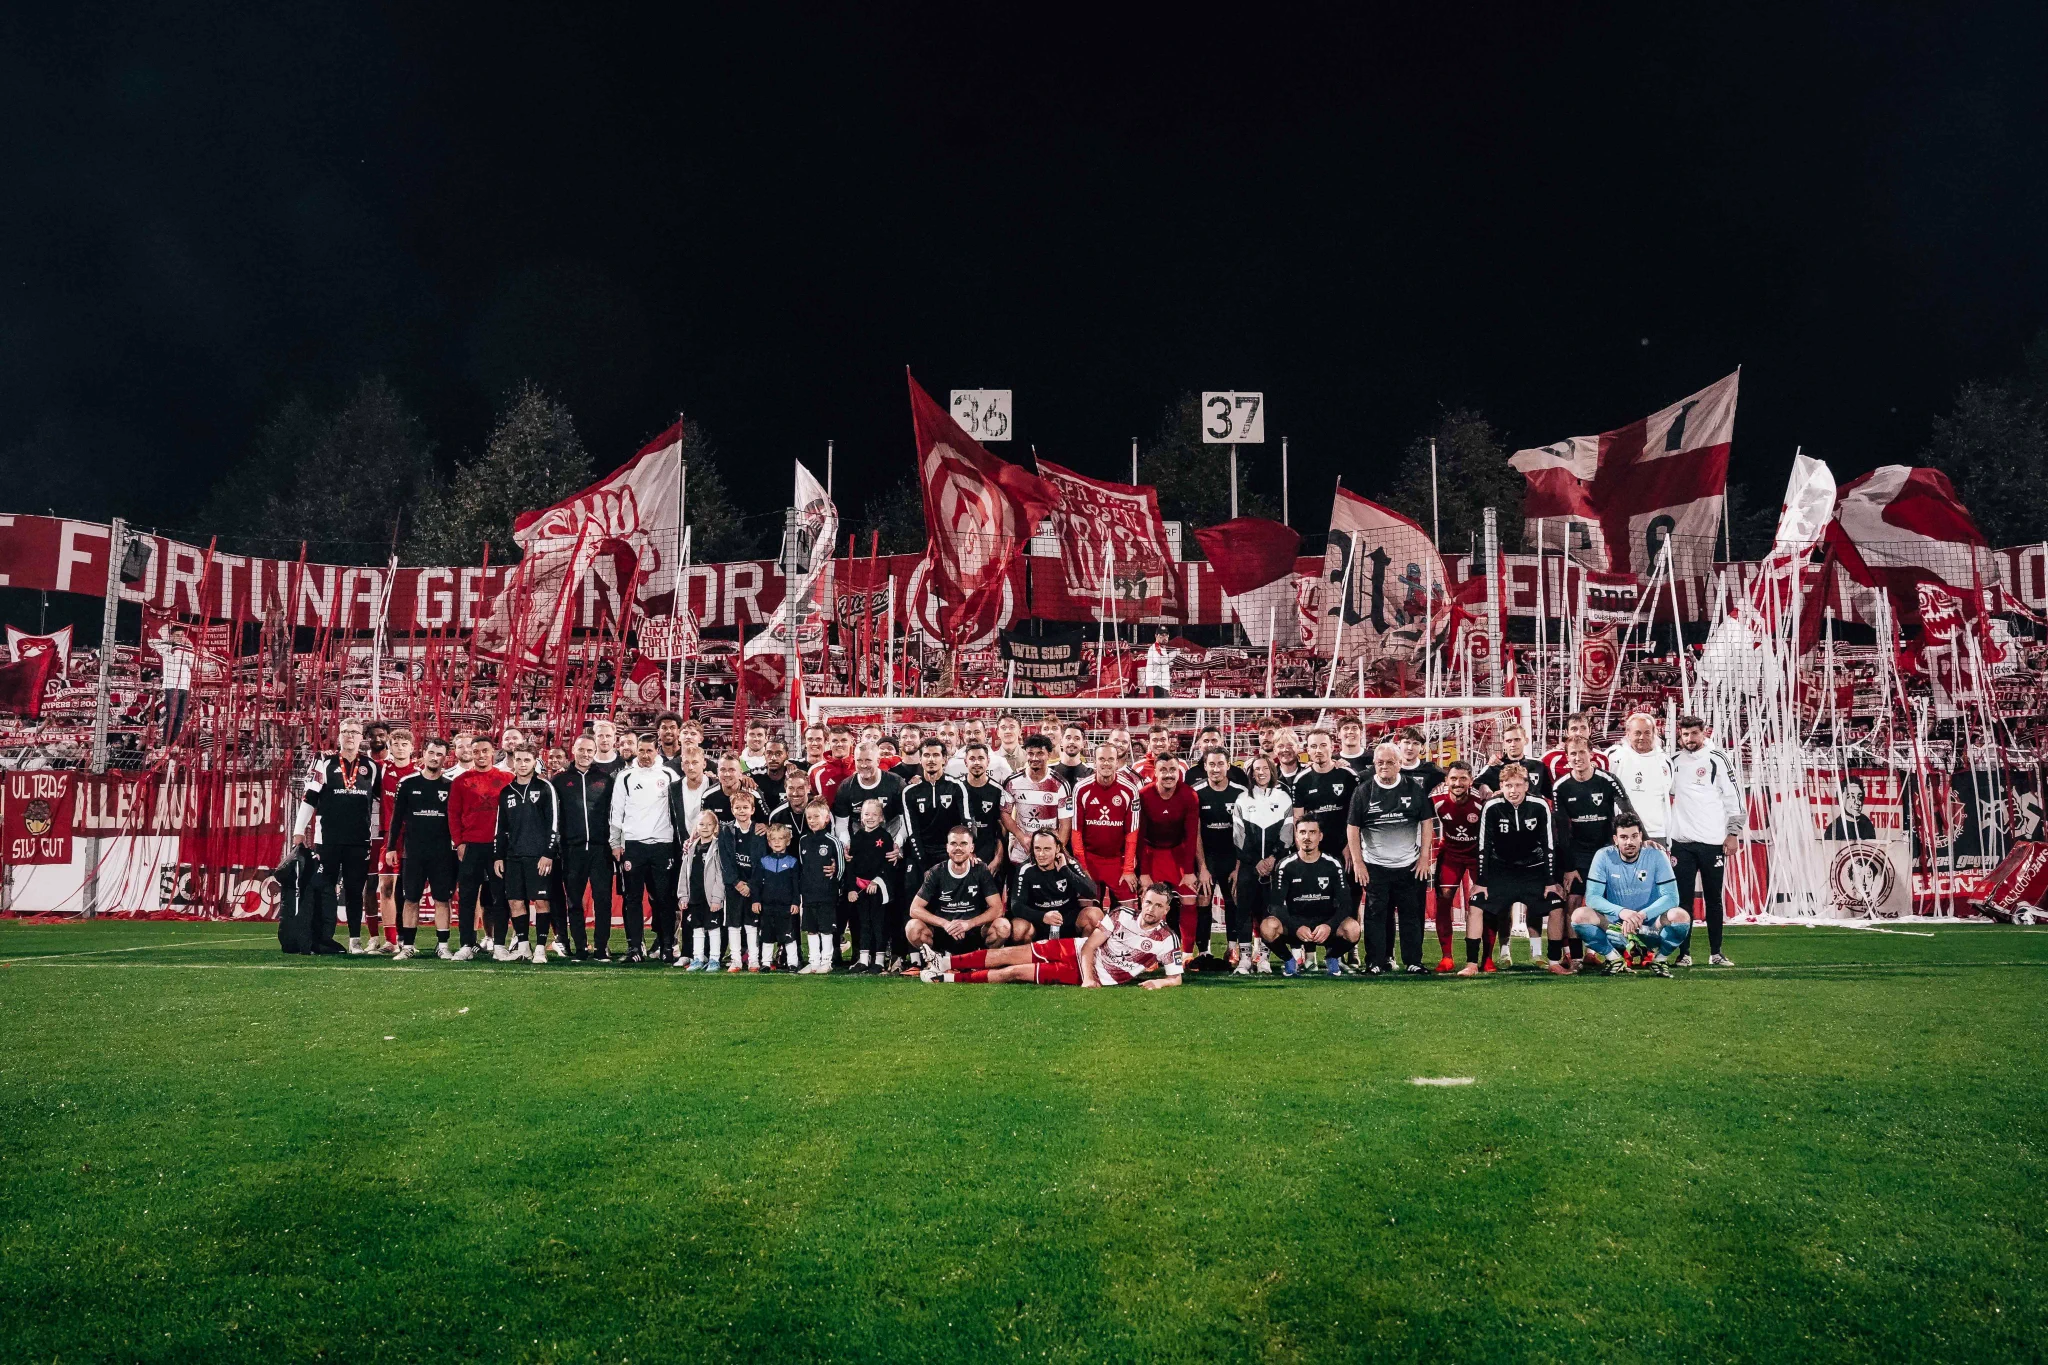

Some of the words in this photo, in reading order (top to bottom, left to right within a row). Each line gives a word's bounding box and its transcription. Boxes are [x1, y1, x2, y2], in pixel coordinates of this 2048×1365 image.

[953, 394, 1008, 437] 36
[1206, 395, 1261, 439] 37
[644, 627, 663, 638] UM
[1009, 641, 1039, 660] WIR
[1041, 645, 1071, 660] SIND
[1476, 648, 1487, 656] 95
[1001, 659, 1080, 678] USTERBLIC
[12, 770, 68, 800] ULTRAS
[1806, 775, 1899, 800] UNTED
[507, 798, 516, 808] 28
[918, 803, 925, 813] 9
[1086, 819, 1124, 828] TARGOBANK
[1499, 824, 1509, 834] 13
[41, 837, 64, 858] GUT
